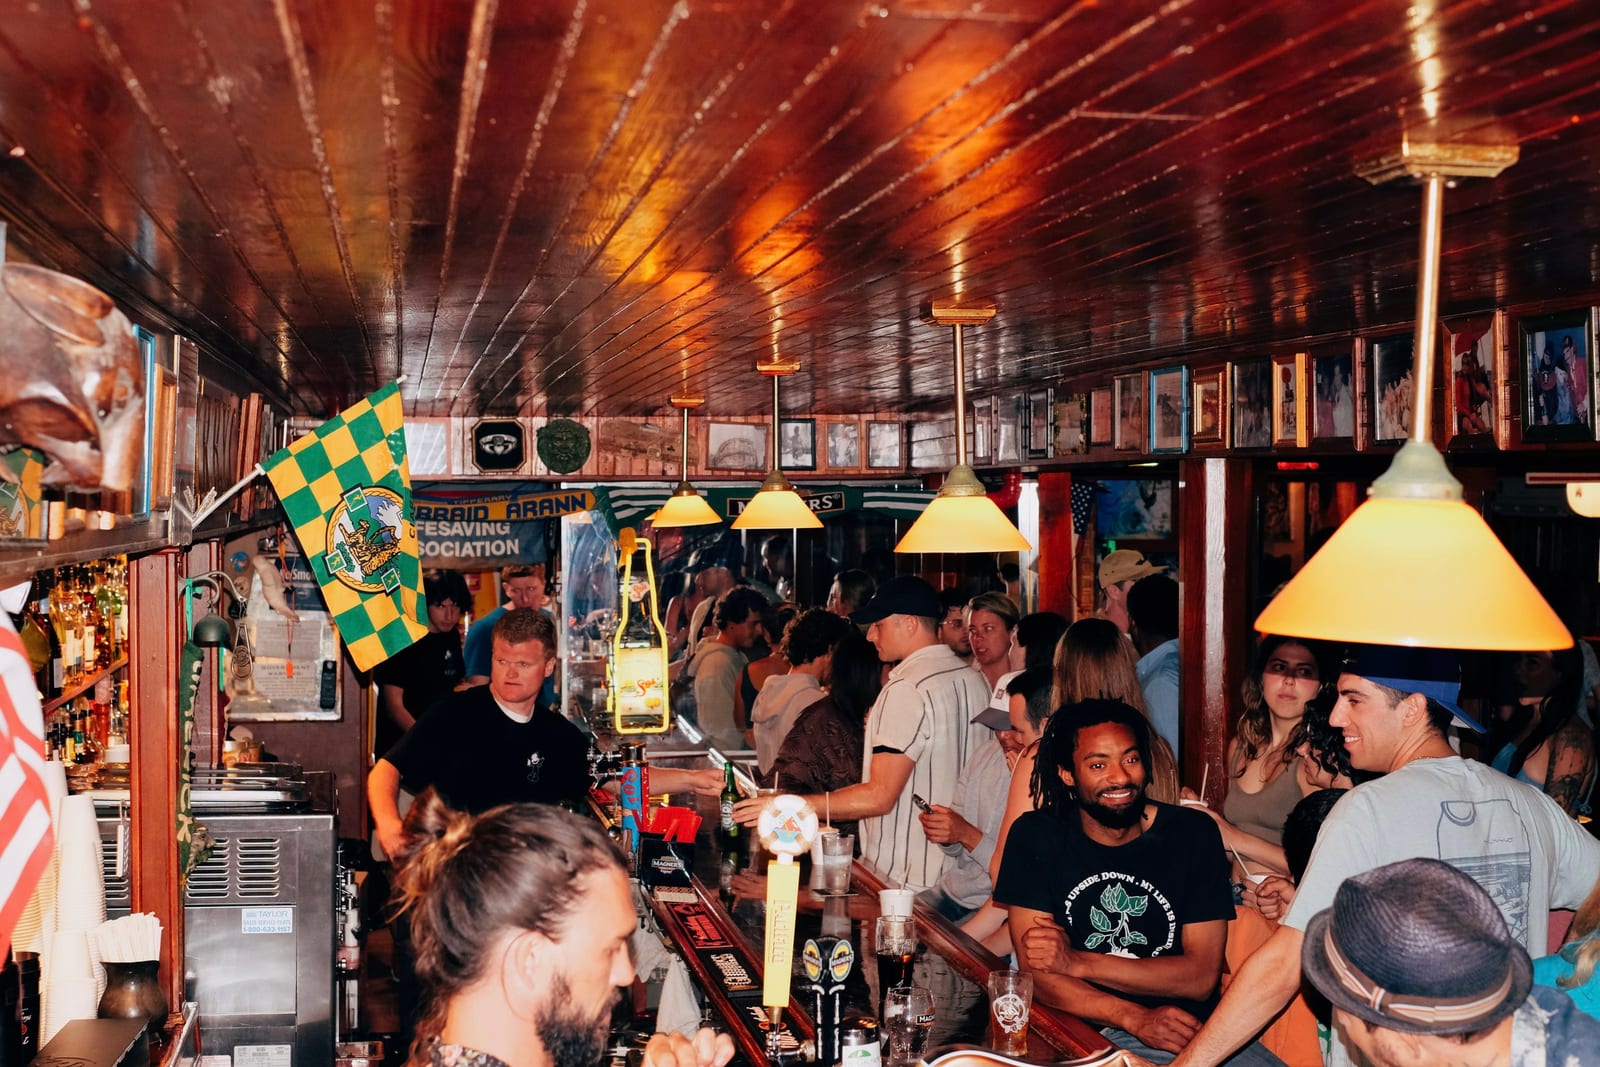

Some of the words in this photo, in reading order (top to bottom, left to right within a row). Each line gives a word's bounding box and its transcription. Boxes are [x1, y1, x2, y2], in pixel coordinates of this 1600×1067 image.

[506, 492, 586, 519] ARANN
[1067, 874, 1101, 900] UPSIDE
[1101, 871, 1135, 884] DOWN
[1140, 879, 1155, 893] MY
[1152, 889, 1171, 912] LIFE
[1166, 909, 1176, 921] IS
